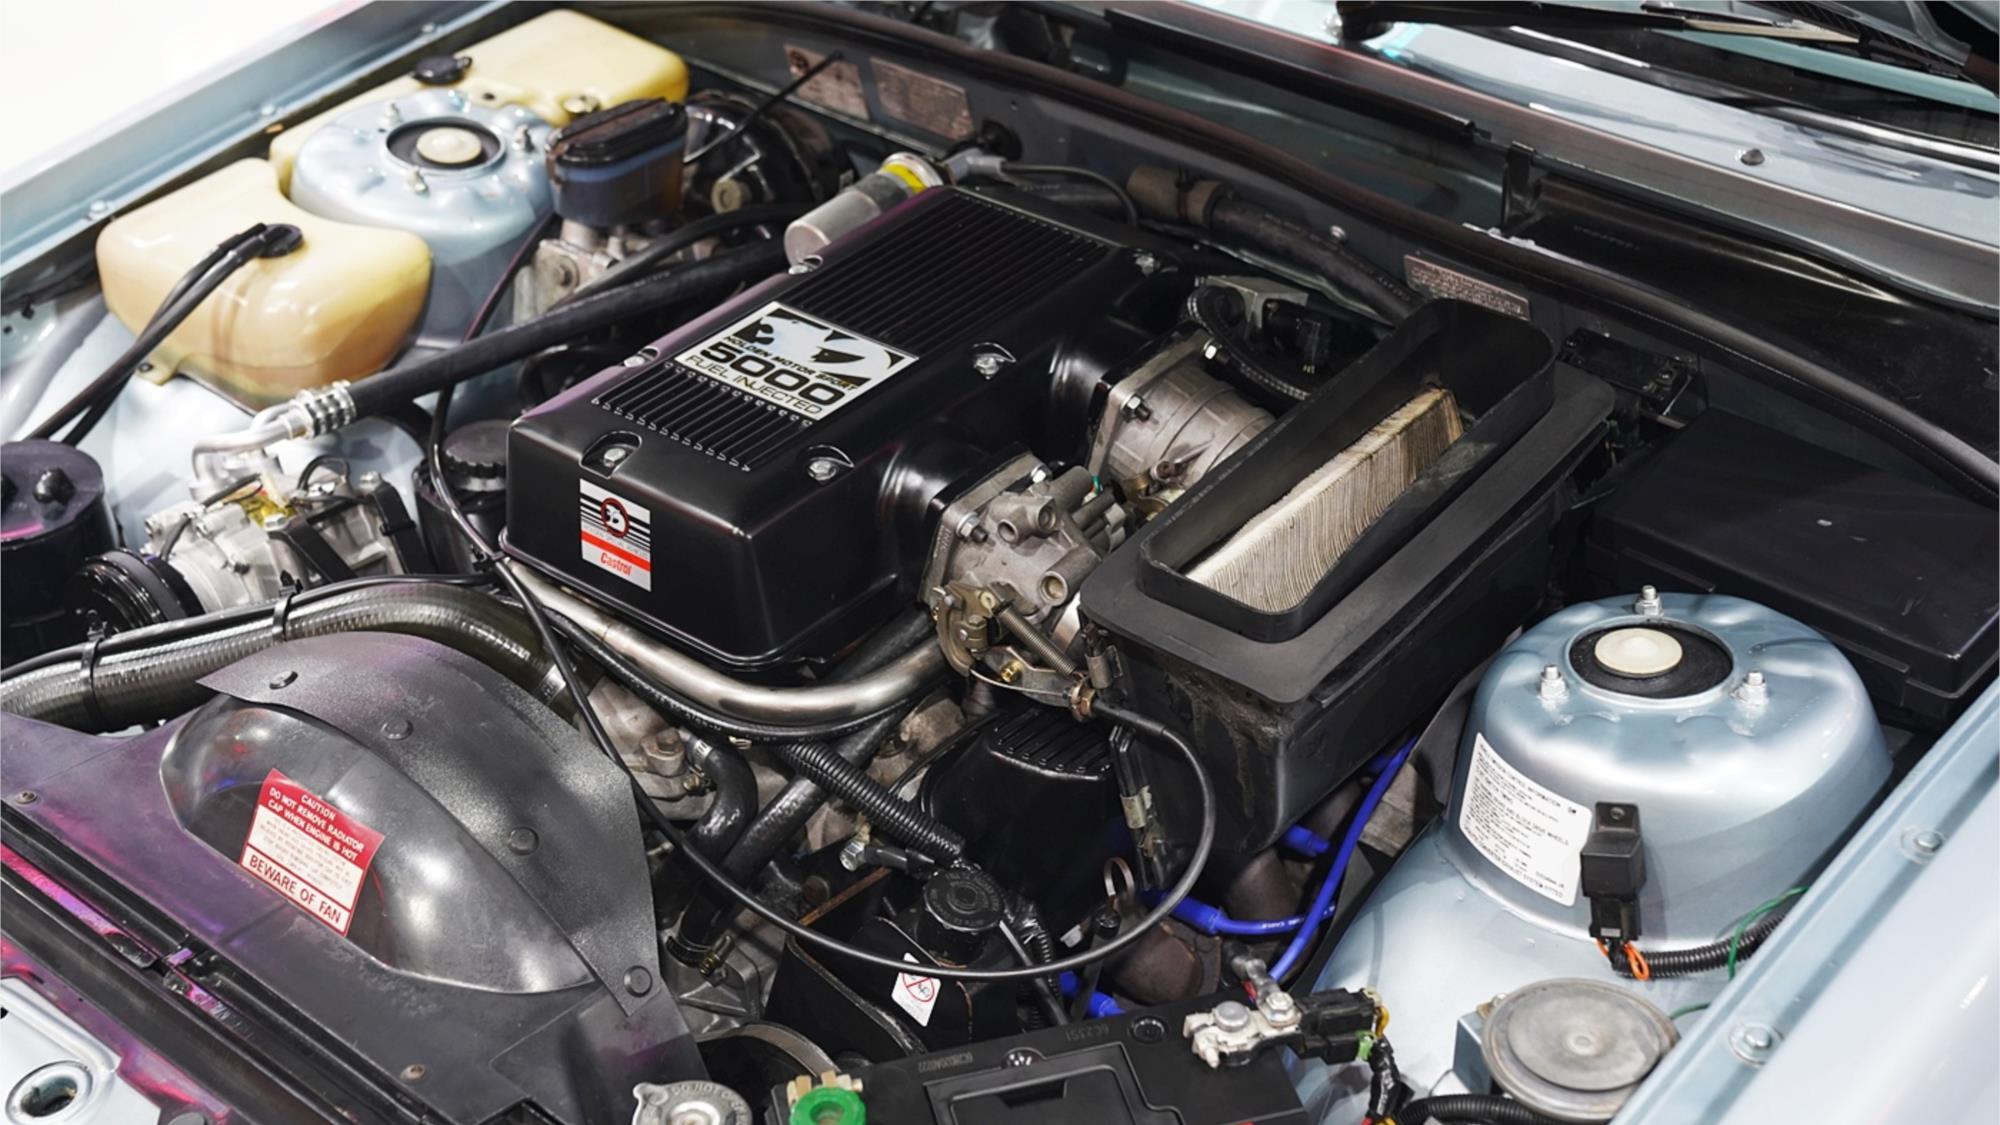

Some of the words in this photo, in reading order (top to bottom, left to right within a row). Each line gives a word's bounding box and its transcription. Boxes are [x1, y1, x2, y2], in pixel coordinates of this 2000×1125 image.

[685, 354, 730, 379] FUEL
[732, 373, 823, 416] INJECTED
[699, 340, 846, 407] 5000
[722, 334, 773, 359] HOLDEN
[770, 355, 818, 377] MOTOR
[815, 371, 861, 392] SPORT
[600, 552, 632, 575] Castrol
[268, 800, 284, 813] CAP
[283, 809, 306, 828] WHEN
[305, 822, 332, 847] ENGINE
[332, 840, 341, 852] IS
[341, 846, 359, 862] HOT
[269, 787, 282, 800] DO
[281, 796, 298, 810] NOT
[297, 804, 327, 829] REMOVE
[327, 824, 366, 852] RADIATOR
[301, 794, 337, 820] CAUTION
[249, 854, 298, 894] BEWARE
[299, 888, 316, 905] OF
[318, 900, 342, 924] FAN
